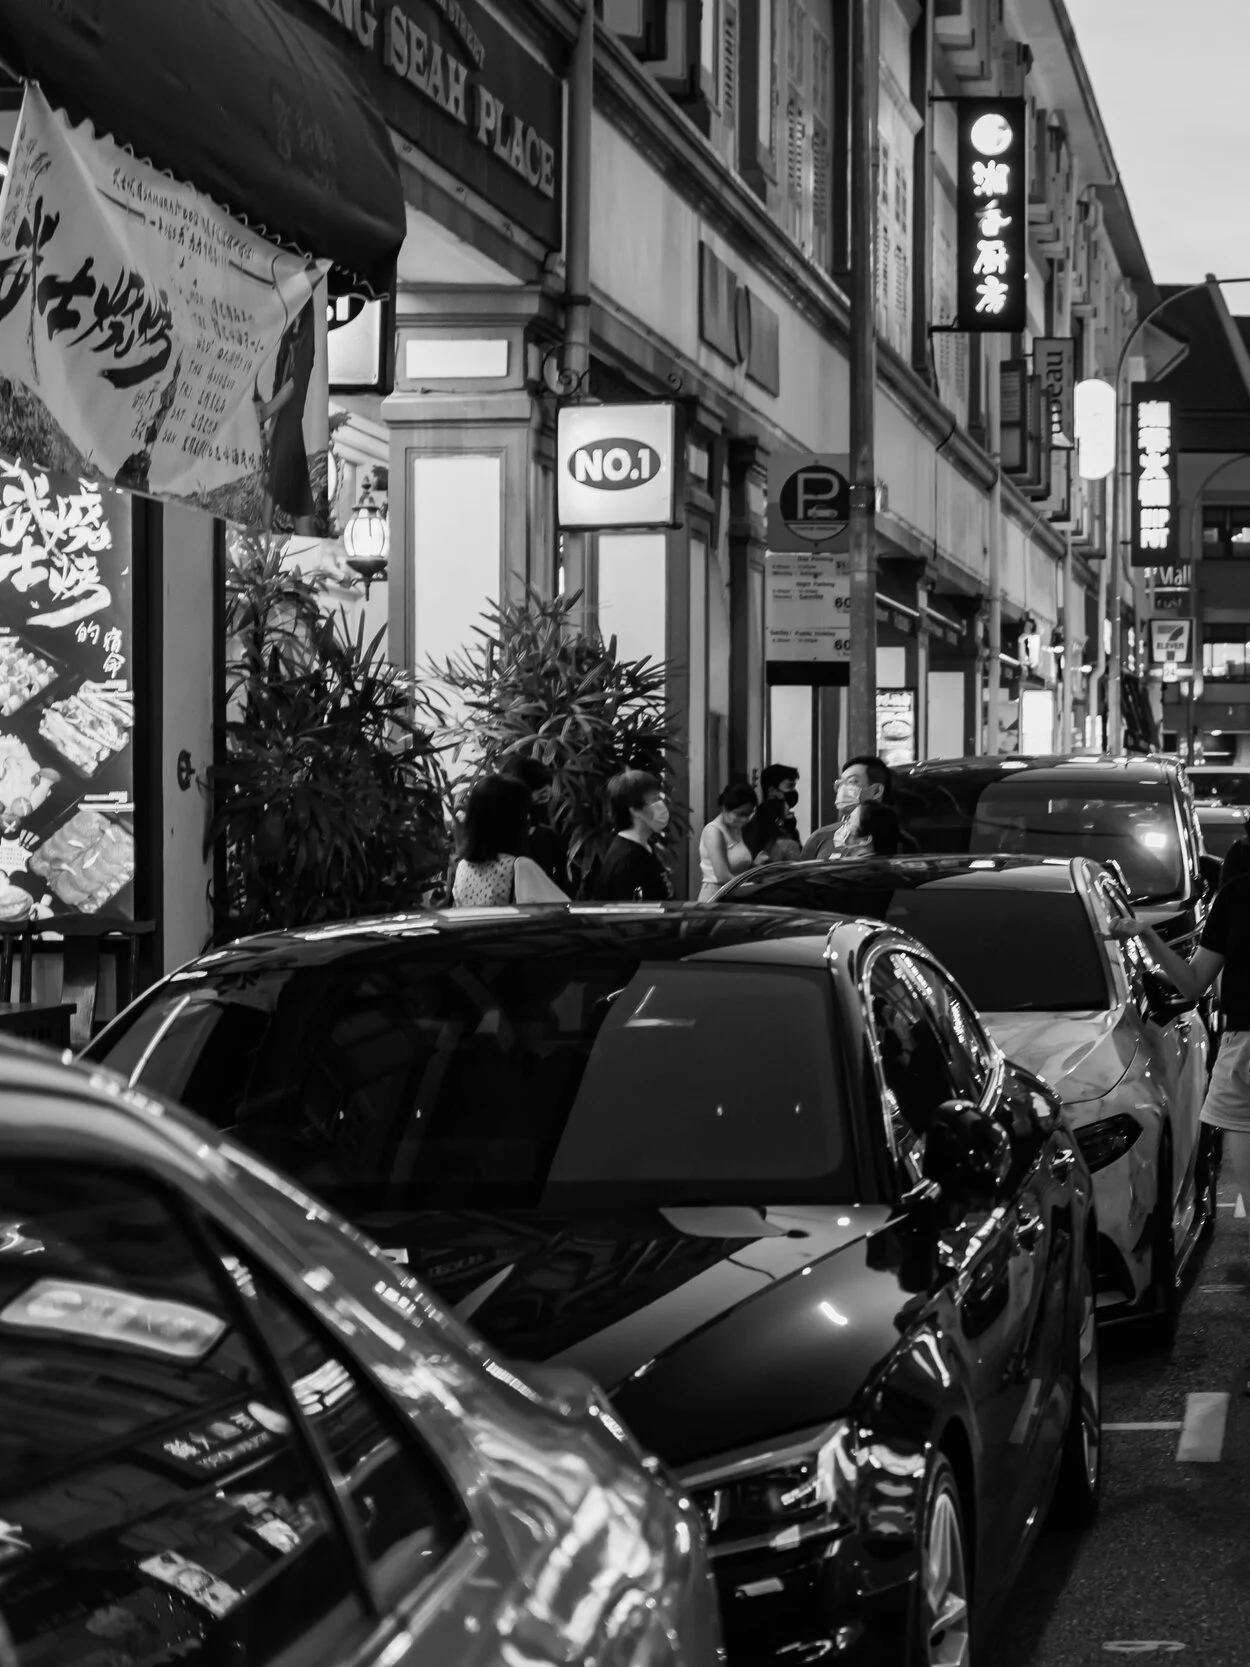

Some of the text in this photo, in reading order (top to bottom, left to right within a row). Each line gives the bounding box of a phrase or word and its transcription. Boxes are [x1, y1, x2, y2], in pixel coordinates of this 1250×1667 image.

[391, 5, 468, 125] SEAH
[476, 84, 554, 199] PLACE
[575, 447, 651, 482] NO.1
